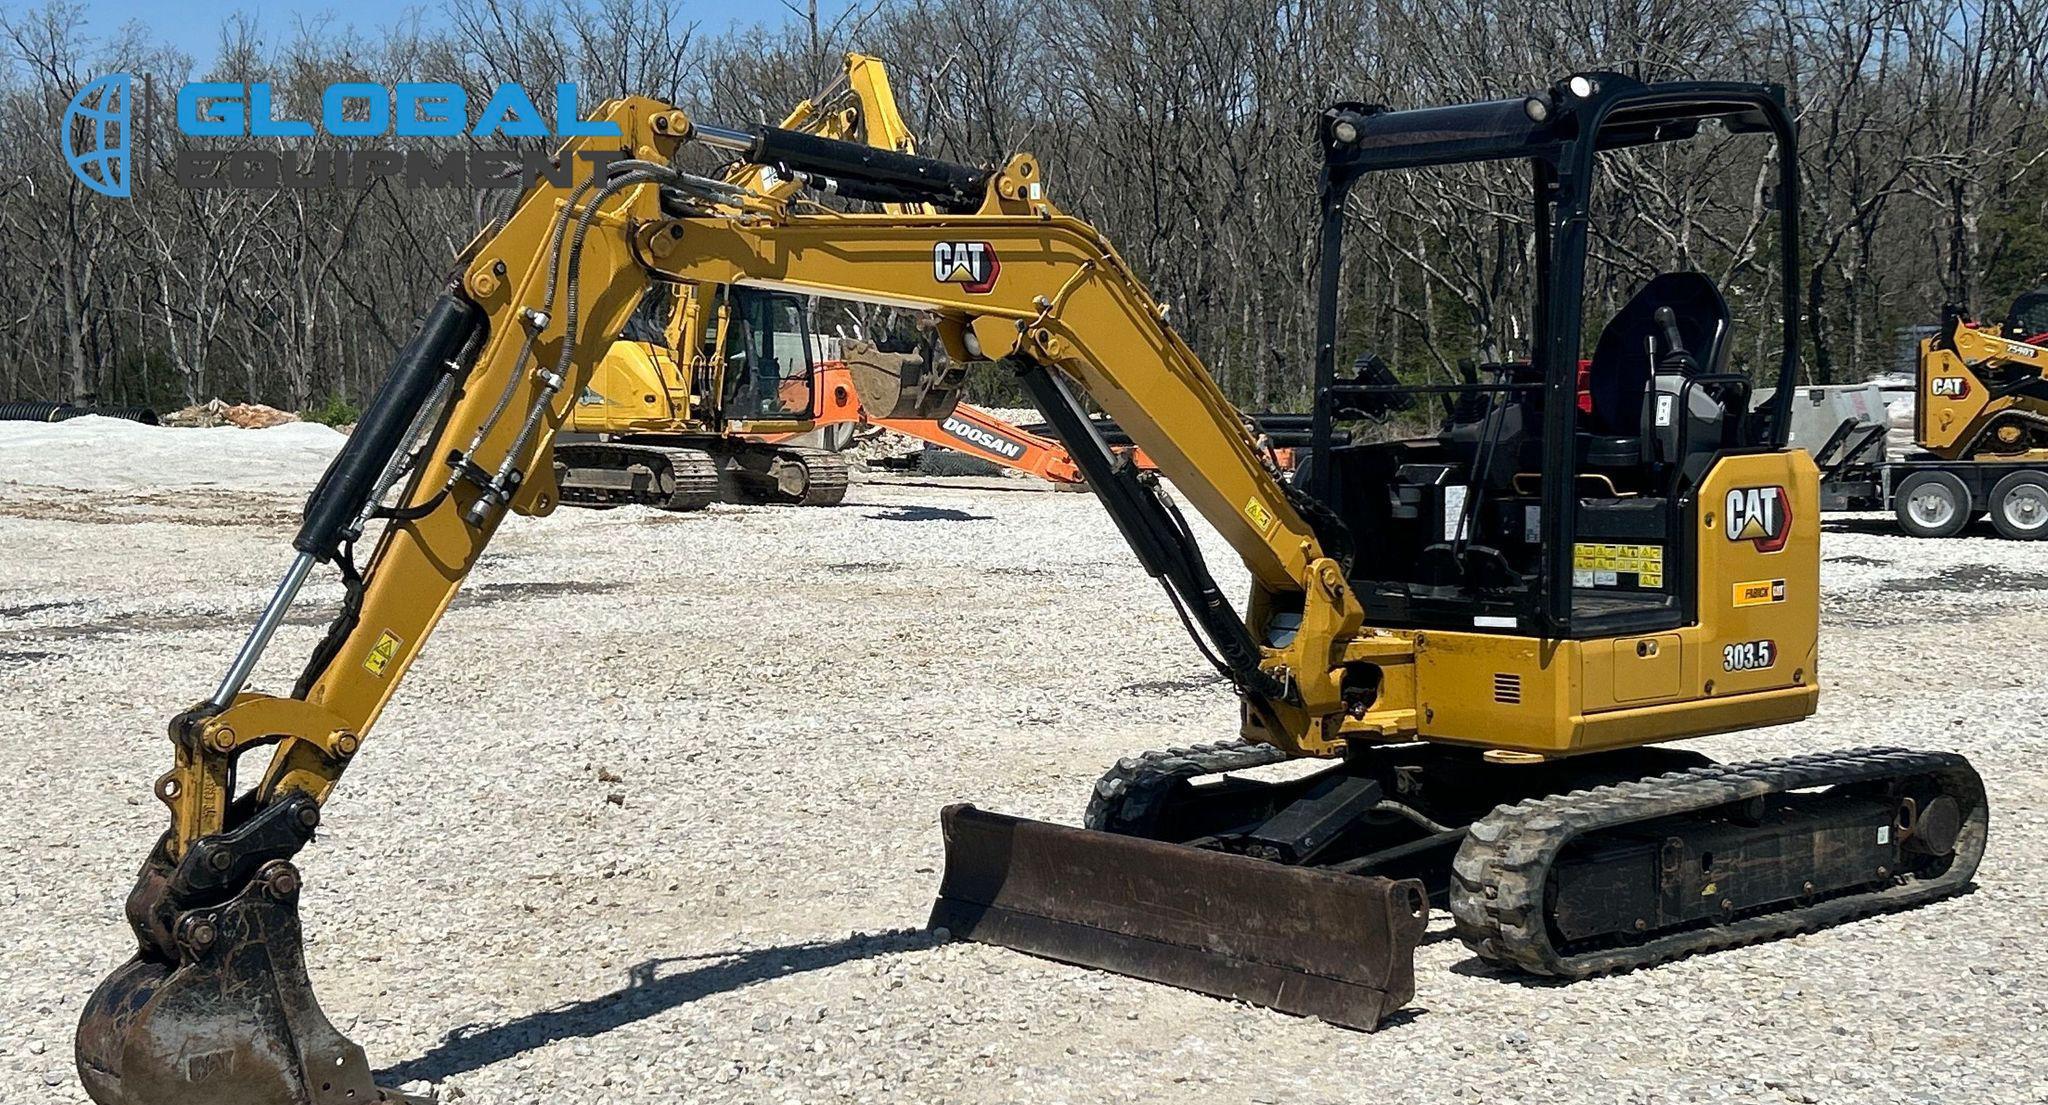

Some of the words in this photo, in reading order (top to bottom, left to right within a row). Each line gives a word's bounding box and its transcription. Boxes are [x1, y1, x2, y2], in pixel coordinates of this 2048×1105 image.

[934, 242, 984, 282] CAT
[1932, 378, 1963, 395] CAT
[942, 417, 1020, 457] DOOSAN
[1726, 487, 1778, 540] CAT
[1723, 641, 1769, 671] 303.5
